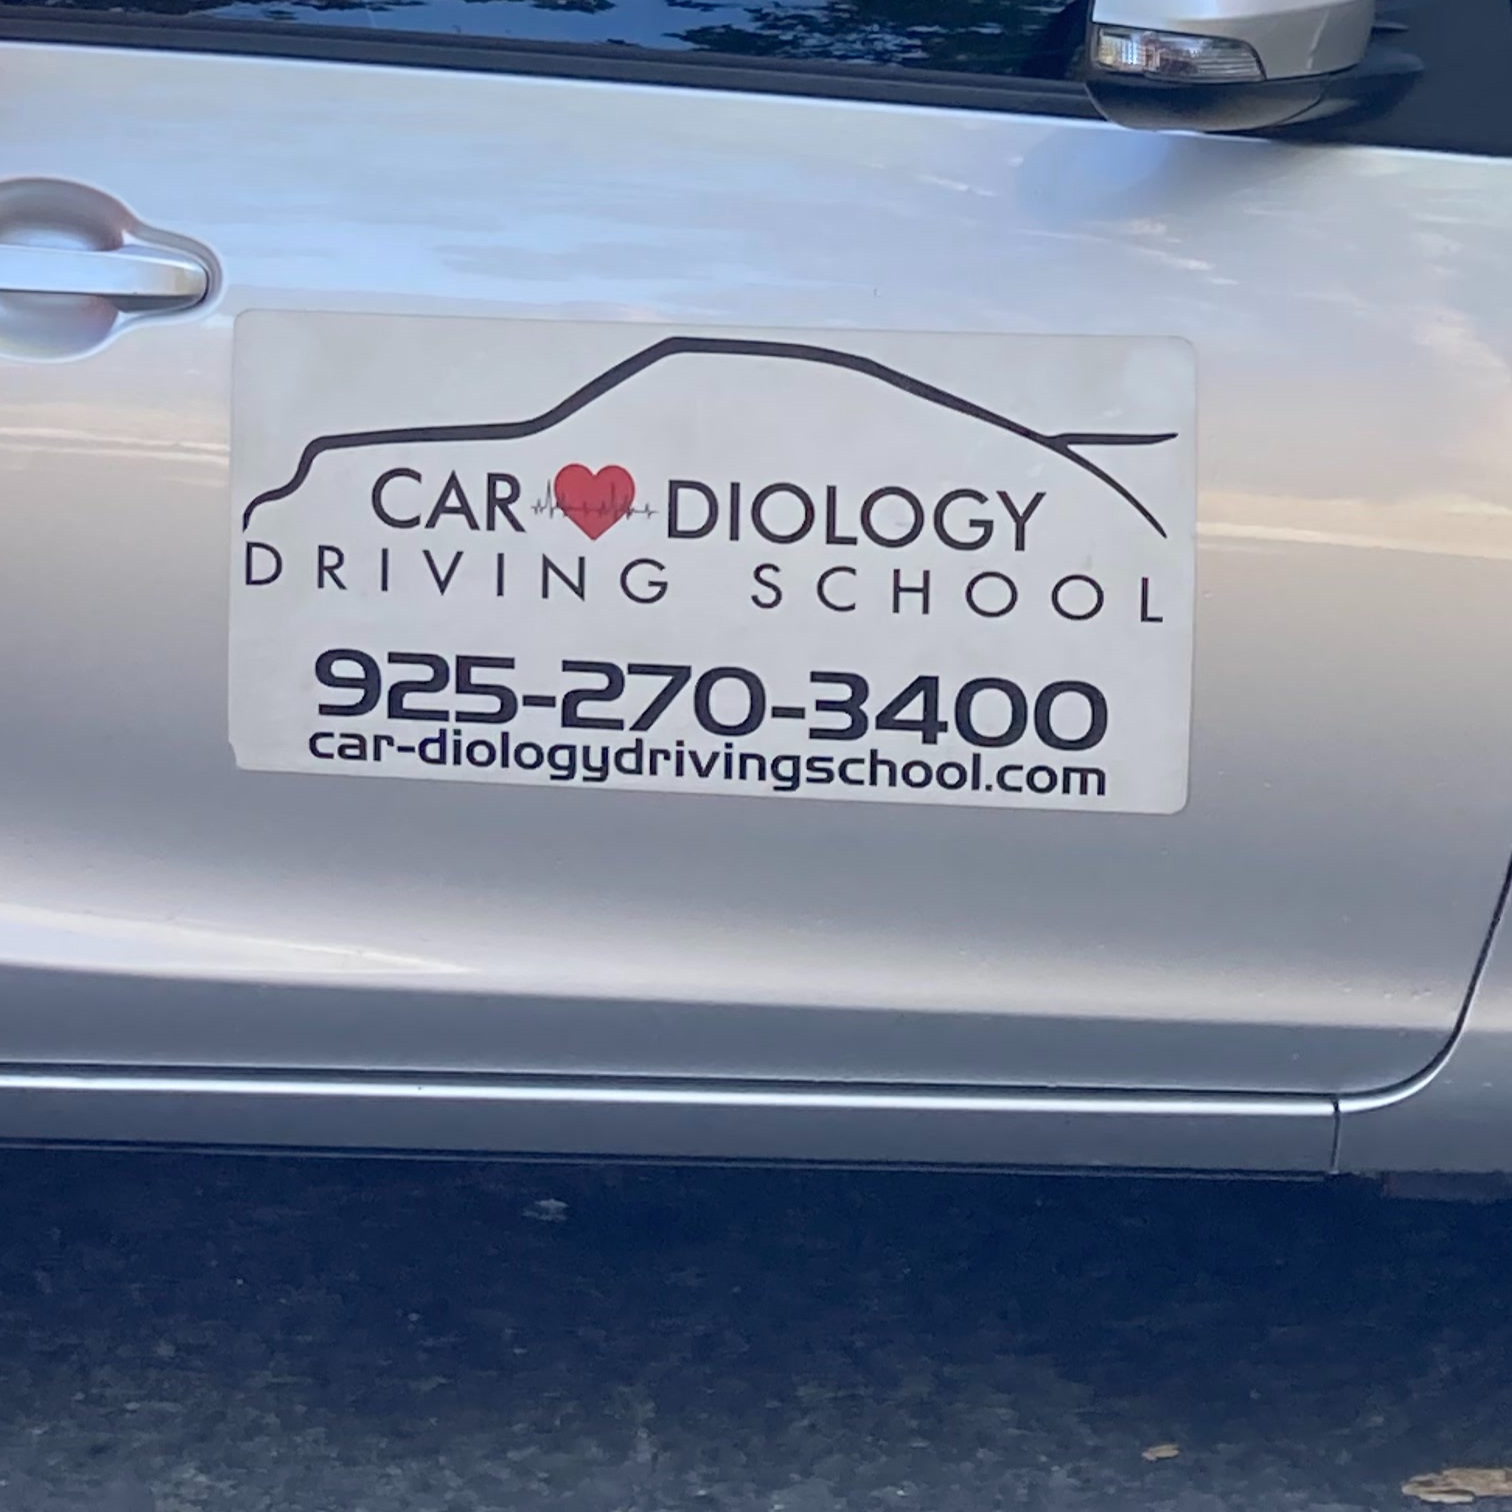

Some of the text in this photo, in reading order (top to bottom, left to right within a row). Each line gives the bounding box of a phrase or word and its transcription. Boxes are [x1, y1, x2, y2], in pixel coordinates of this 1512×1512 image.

[371, 467, 1047, 552] CAR DIOLOGY
[245, 541, 1164, 623] DRIVING SCHOOL
[314, 648, 1108, 752] 925-270-3400
[308, 727, 1106, 796] car-diologydrivingschool.com
